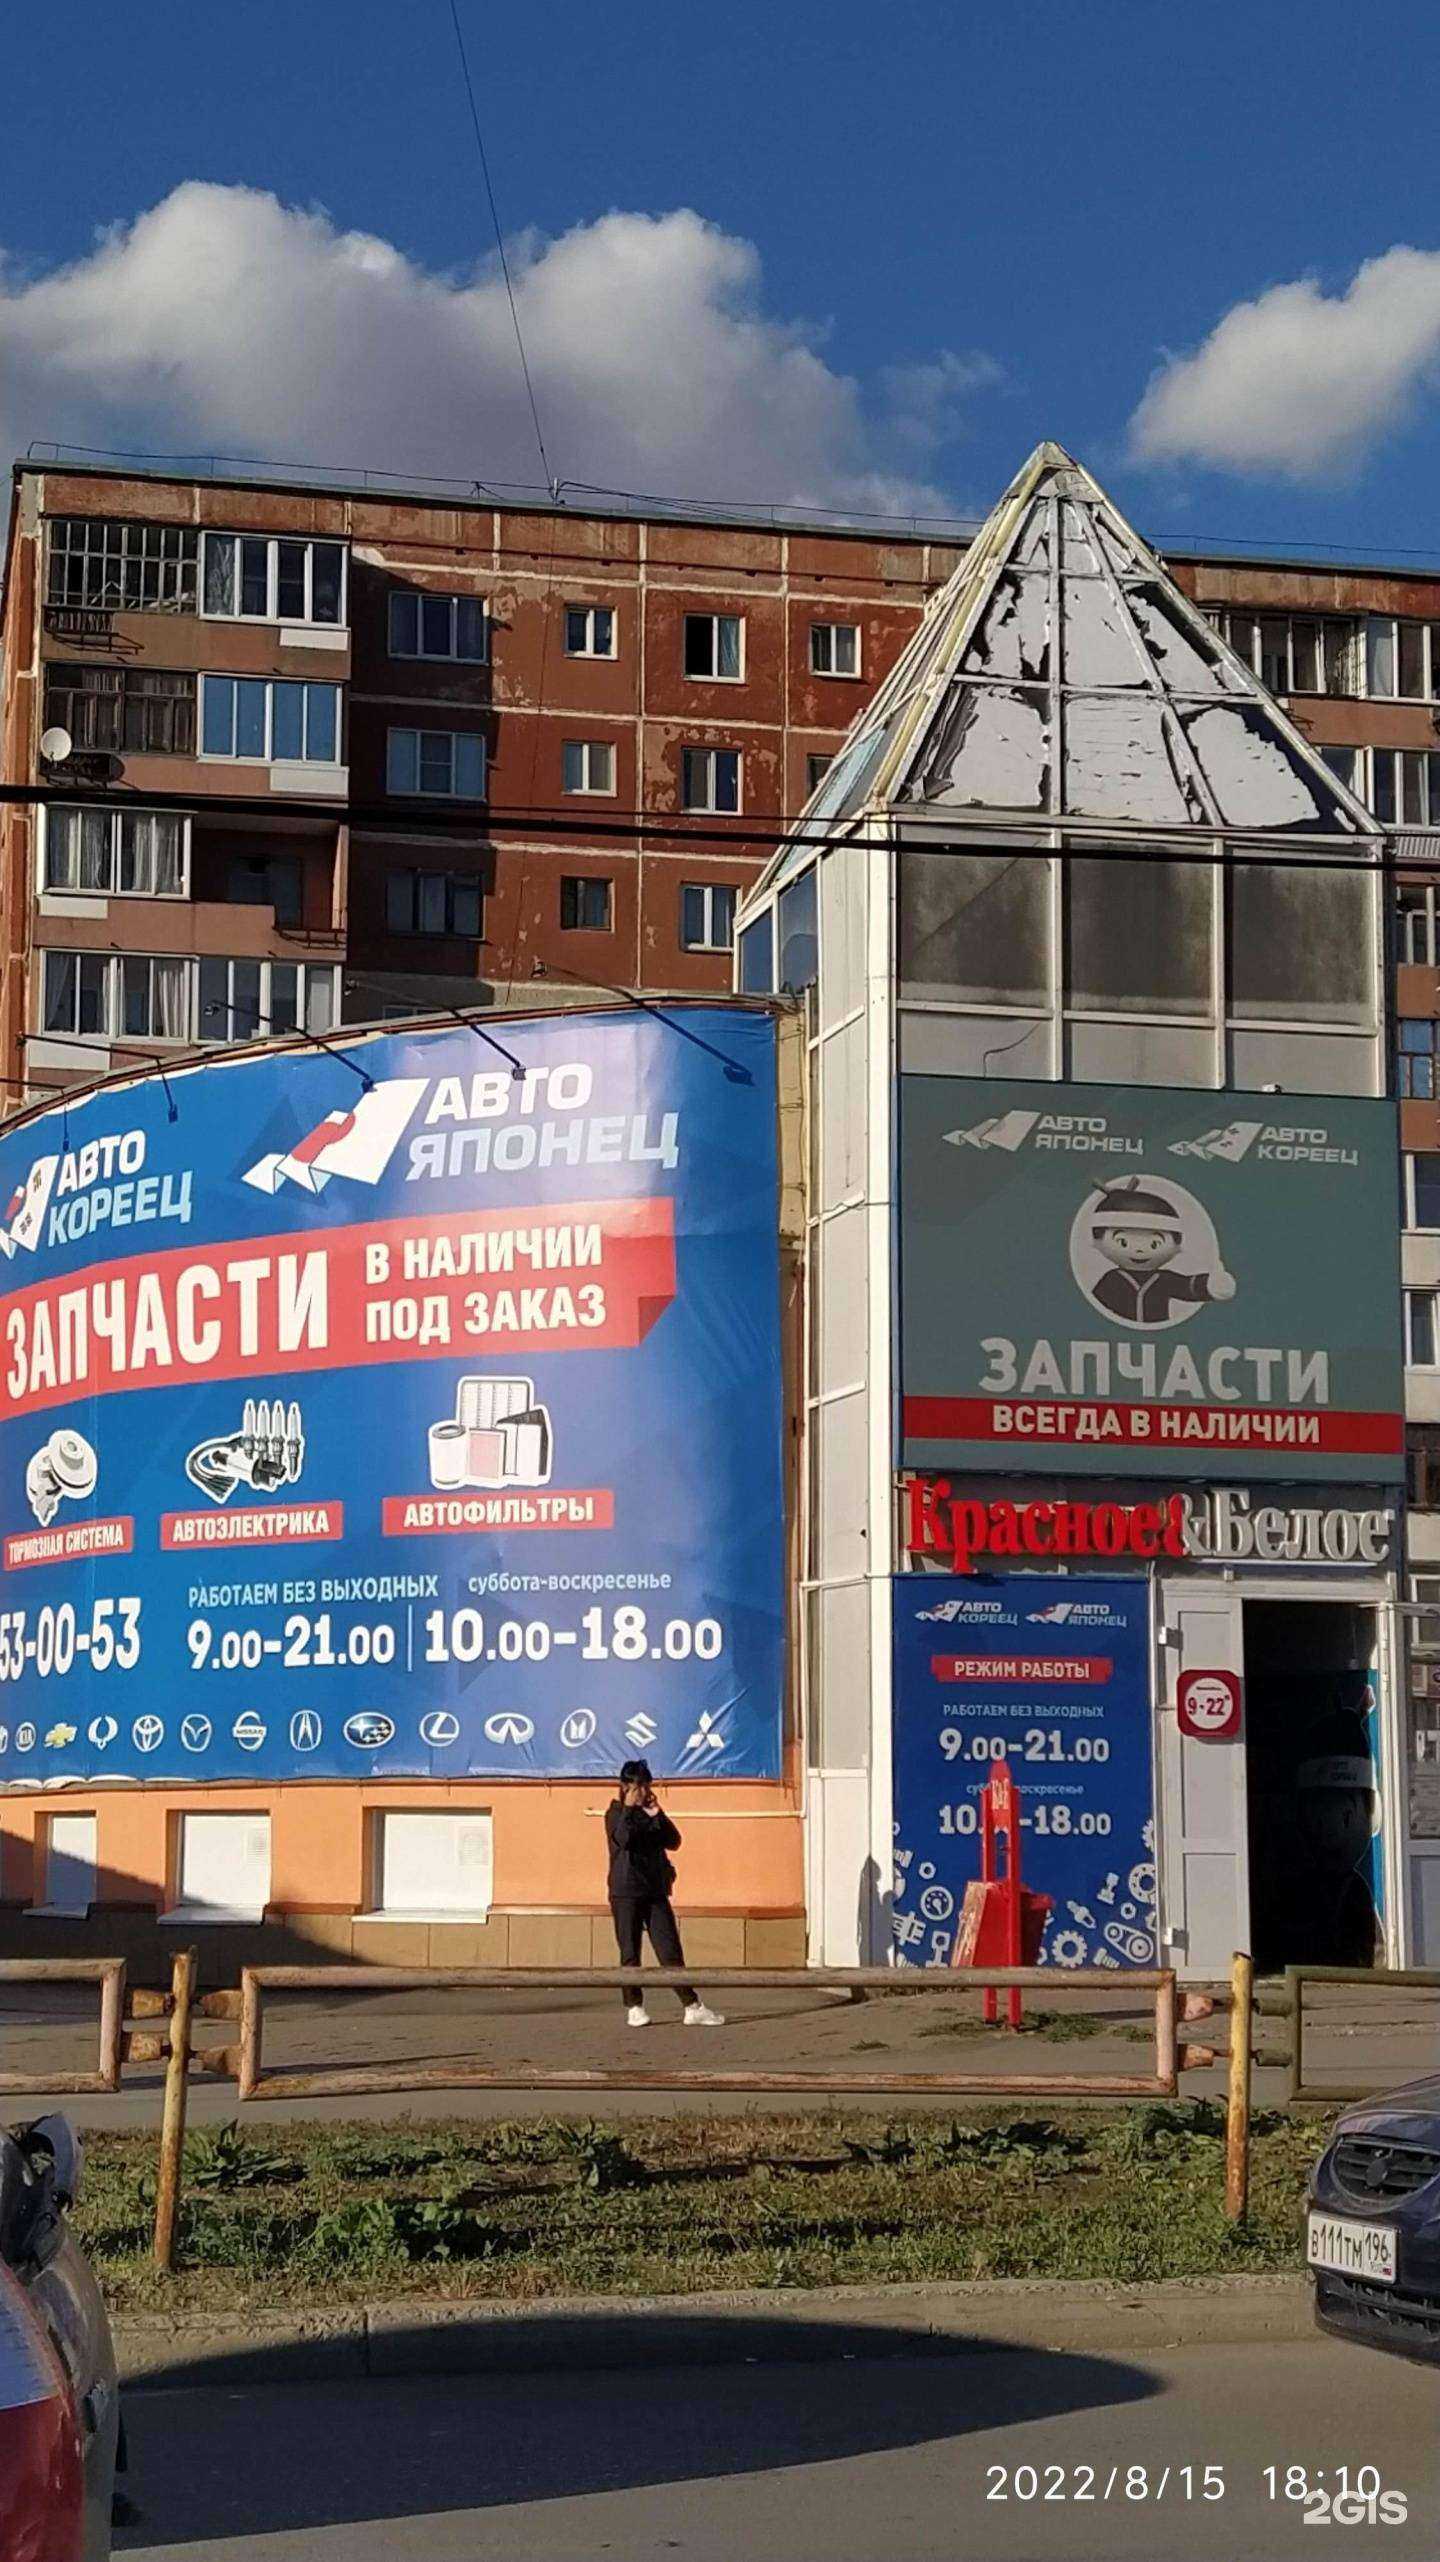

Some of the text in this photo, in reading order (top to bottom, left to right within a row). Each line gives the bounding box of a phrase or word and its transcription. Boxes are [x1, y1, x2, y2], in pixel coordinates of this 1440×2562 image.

[424, 1062, 593, 1125] АВТО
[1039, 1115, 1107, 1133] АВТО
[1261, 1126, 1328, 1144] АВТО
[58, 1130, 146, 1193] АВТО
[405, 1112, 679, 1182] ЯПОНЕЦ
[1035, 1133, 1143, 1156] ЯПОНЕЦ
[1257, 1145, 1358, 1166] КОРЕЕЦ
[47, 1171, 192, 1248] КОРЕЕЦ
[366, 1224, 602, 1284] В НАЛИЧИИ
[6, 1251, 328, 1400] ЗАПЧАСТИ
[366, 1284, 606, 1346] ПОД ЗАКАЗ
[978, 1337, 1330, 1405] ЗАПЧАСТИ
[992, 1404, 1320, 1444] ВСЕГДА В НАЛИЧИИ
[172, 1509, 330, 1543] АВТОЭЛЕКТРИКА
[403, 1496, 594, 1528] АВТОФИЛЬТРЫ
[8, 1524, 124, 1564] ТОРМОЗНАЯ СИСТЕМА
[188, 1574, 439, 1608] РАБОТАЕМ БЕЗ ВЫХОДНЫХ
[468, 1573, 672, 1595] суббота-воскресенье
[958, 1613, 1018, 1626] КОРЕЕЦ
[961, 1601, 1002, 1613] АВТО
[1068, 1615, 1128, 1628] ЯПОНЕЦ
[1071, 1604, 1110, 1615] АВТО
[187, 1614, 395, 1669] 9.00-21.00
[425, 1606, 723, 1662] 10.00-18.00
[954, 1661, 1090, 1679] РЕЖИМ РАБОТЫ
[943, 1704, 1104, 1718] РАБОТАЕМ БЕЗ ВЫХОДНЫХ
[939, 1728, 1110, 1762] 9.00-21.00
[939, 1804, 1112, 1836] 10.-18.00
